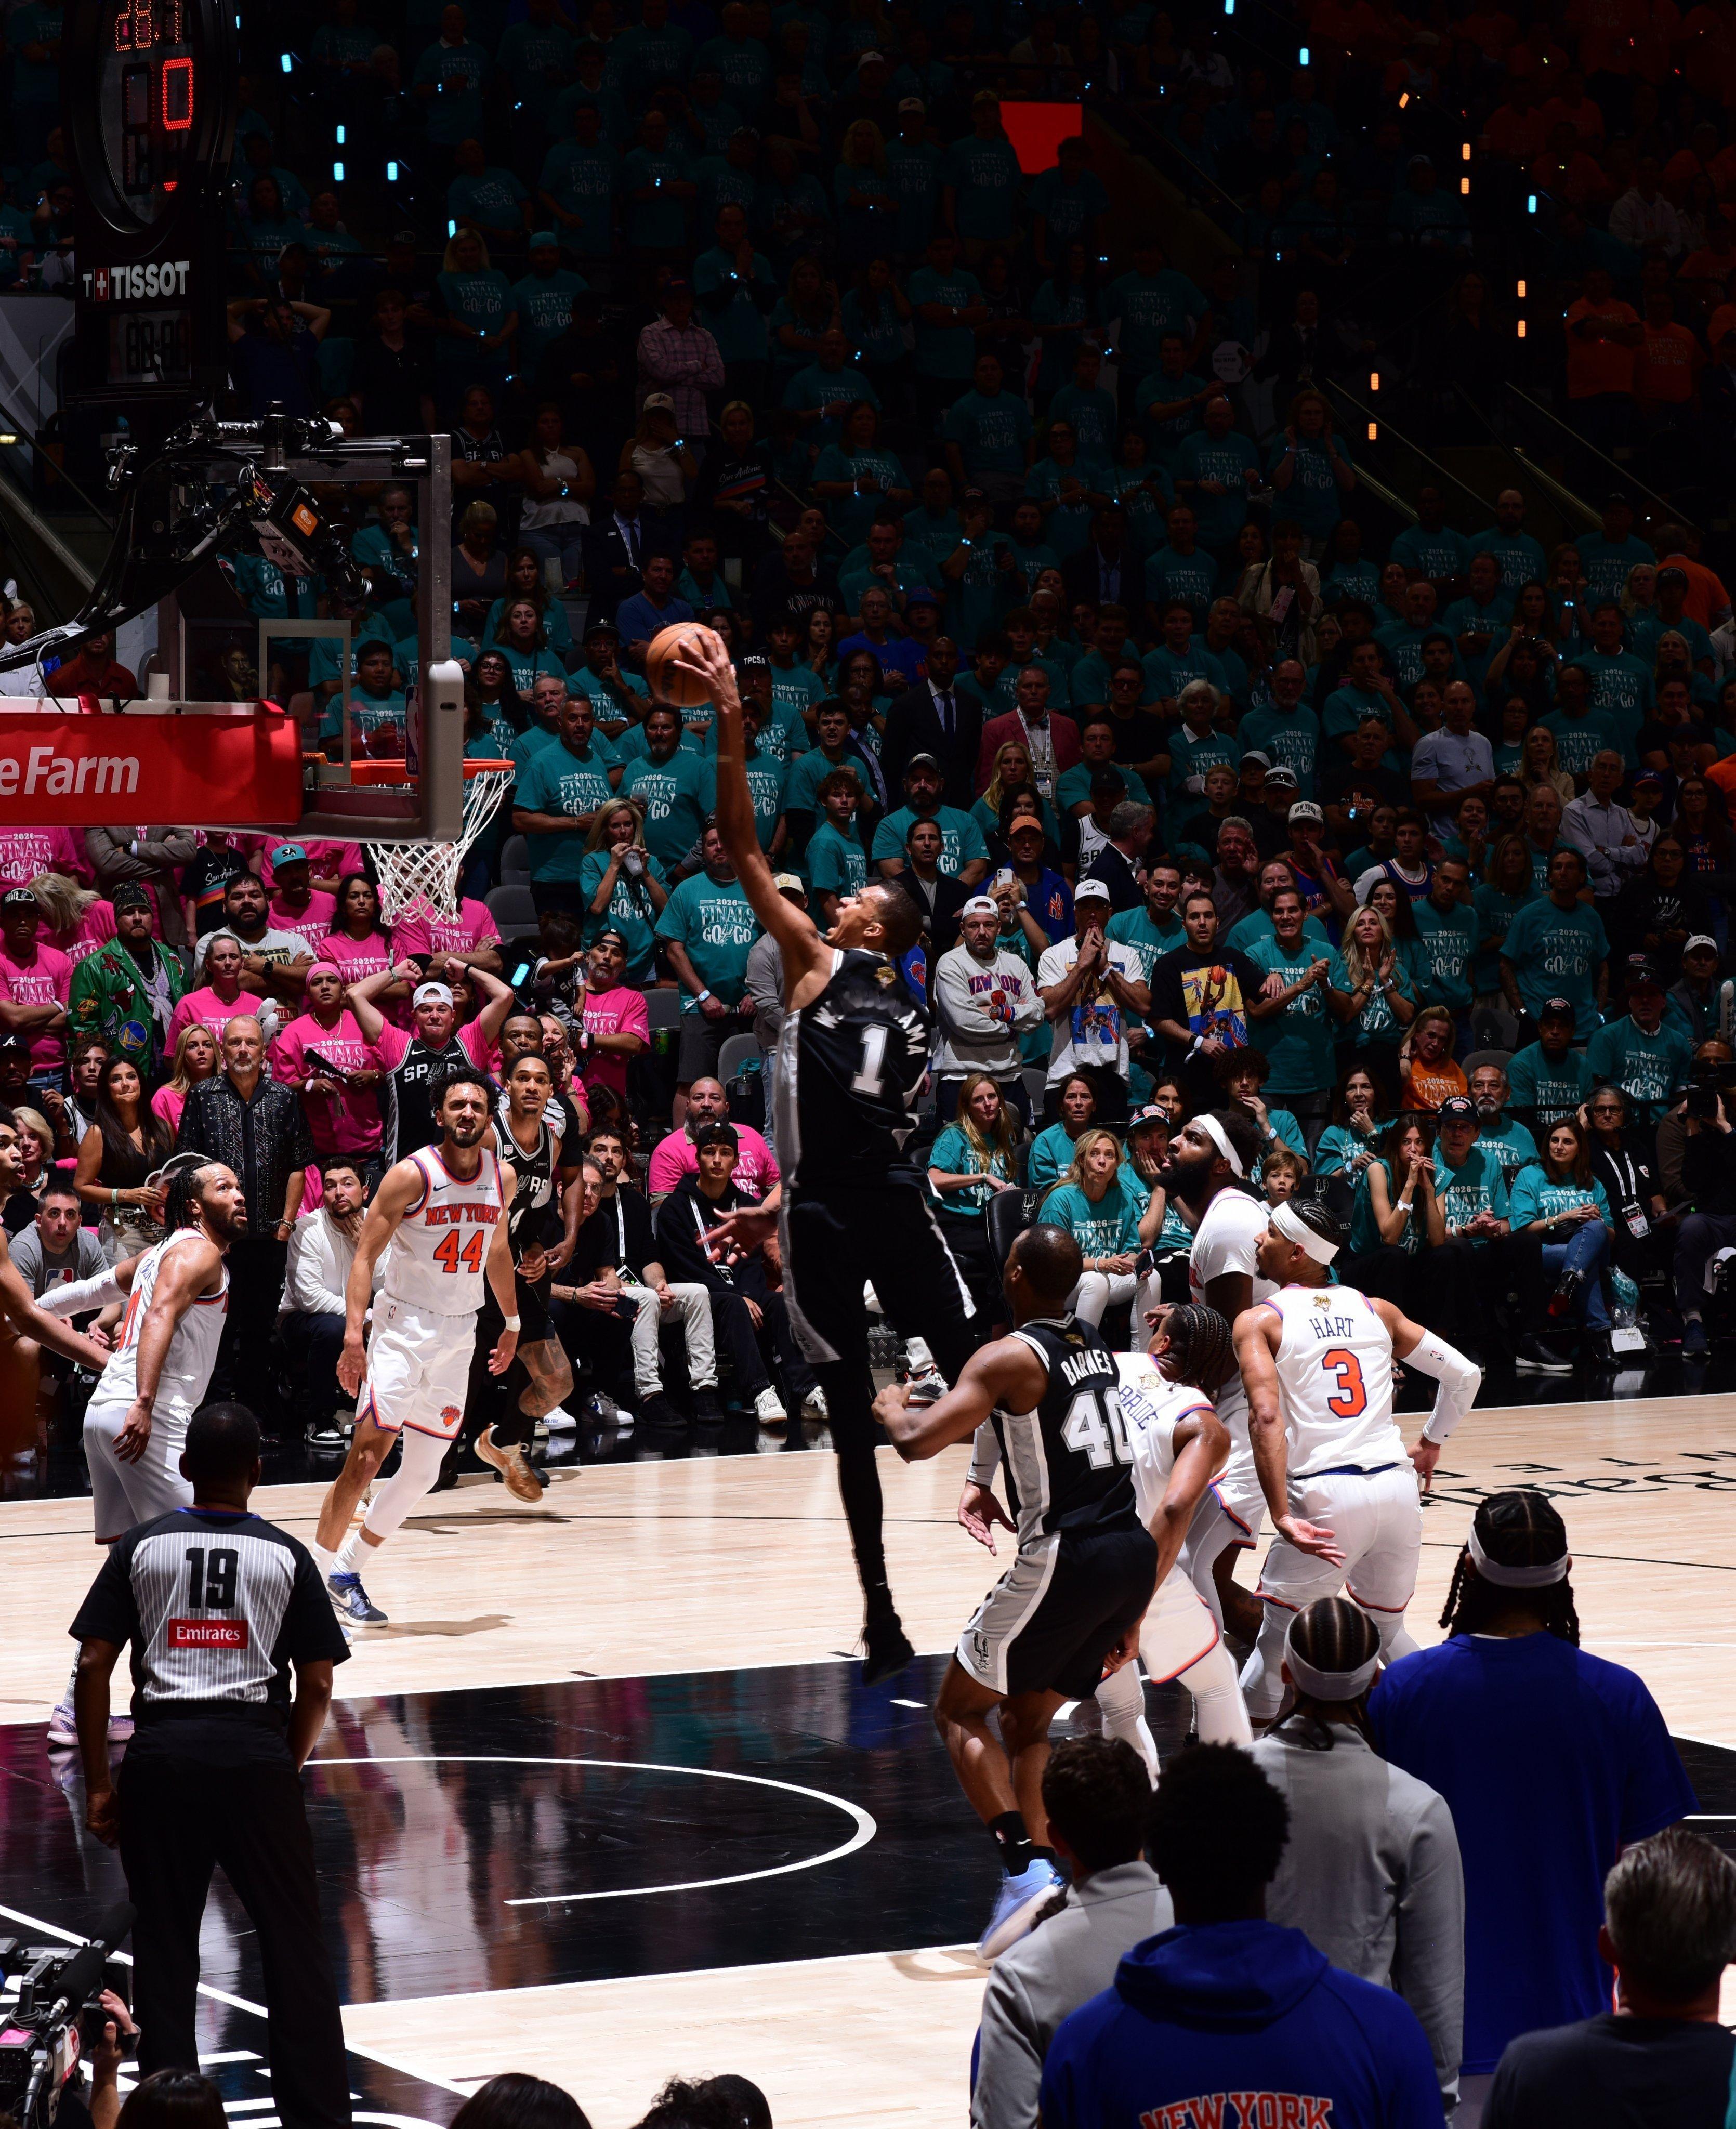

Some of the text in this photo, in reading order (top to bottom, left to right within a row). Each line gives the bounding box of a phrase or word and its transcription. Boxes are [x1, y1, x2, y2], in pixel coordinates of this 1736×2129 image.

[110, 261, 190, 299] TISSOT
[743, 655, 766, 666] TPCSA
[25, 747, 139, 794] Farm
[559, 780, 609, 801] FINALS
[0, 839, 52, 862] FINALS
[296, 923, 318, 931] 2026
[699, 905, 756, 928] FINALS
[733, 928, 752, 945] GO
[1543, 936, 1592, 957] FINALS
[1143, 943, 1163, 955] 2026
[1284, 967, 1305, 975] 2026
[968, 975, 992, 996] NEW
[850, 1023, 889, 1097] 1
[425, 1202, 501, 1226] NEW YORK
[1086, 1219, 1108, 1228] 2026
[433, 1228, 485, 1273] 44
[1308, 1316, 1354, 1339] HART
[1060, 1348, 1112, 1387] BARNES
[1322, 1348, 1368, 1419] 3
[1060, 1386, 1134, 1470] 40
[185, 1547, 240, 1610] 19
[176, 1625, 241, 1641] Emirates
[1139, 2090, 1334, 2129] NEW YORK
